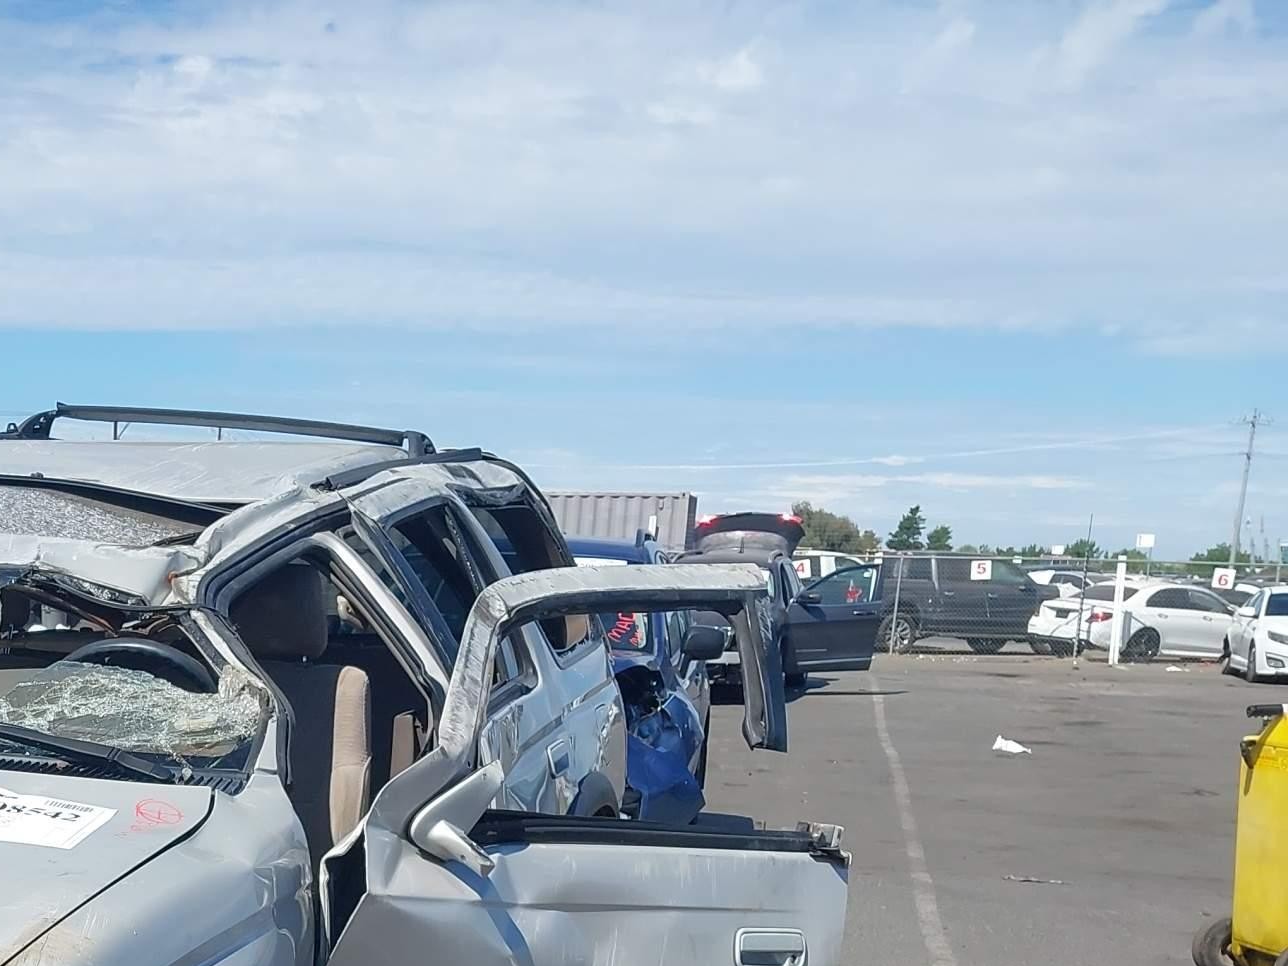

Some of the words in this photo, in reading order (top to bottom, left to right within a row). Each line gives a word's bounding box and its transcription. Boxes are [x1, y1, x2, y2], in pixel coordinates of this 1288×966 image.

[796, 562, 805, 574] 4
[976, 562, 987, 575] 5
[1218, 574, 1229, 586] 6
